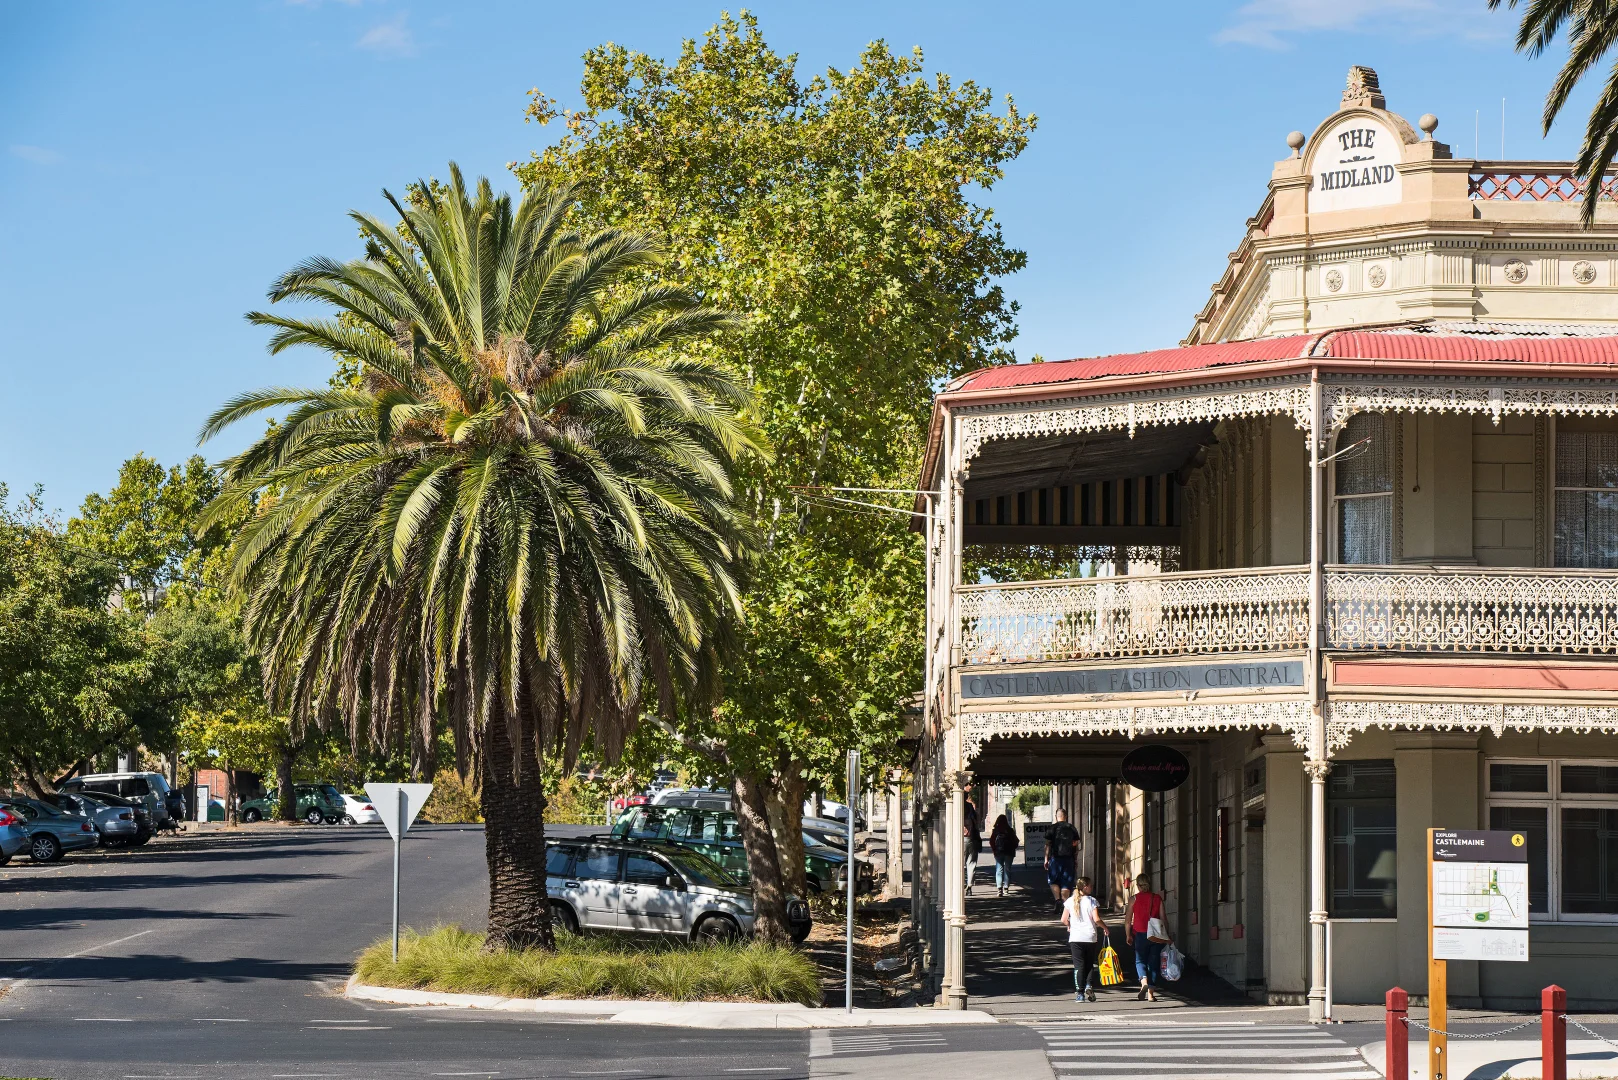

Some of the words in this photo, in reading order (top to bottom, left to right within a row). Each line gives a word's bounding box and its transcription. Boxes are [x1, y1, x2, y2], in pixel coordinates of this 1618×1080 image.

[1338, 128, 1376, 151] THE
[1320, 164, 1395, 191] MIDLAND
[969, 674, 1098, 695] CASTLEMAINE
[1109, 670, 1191, 691] FASHION
[1204, 665, 1295, 687] CENTRAL
[1435, 838, 1485, 846] CASTLEMAINE
